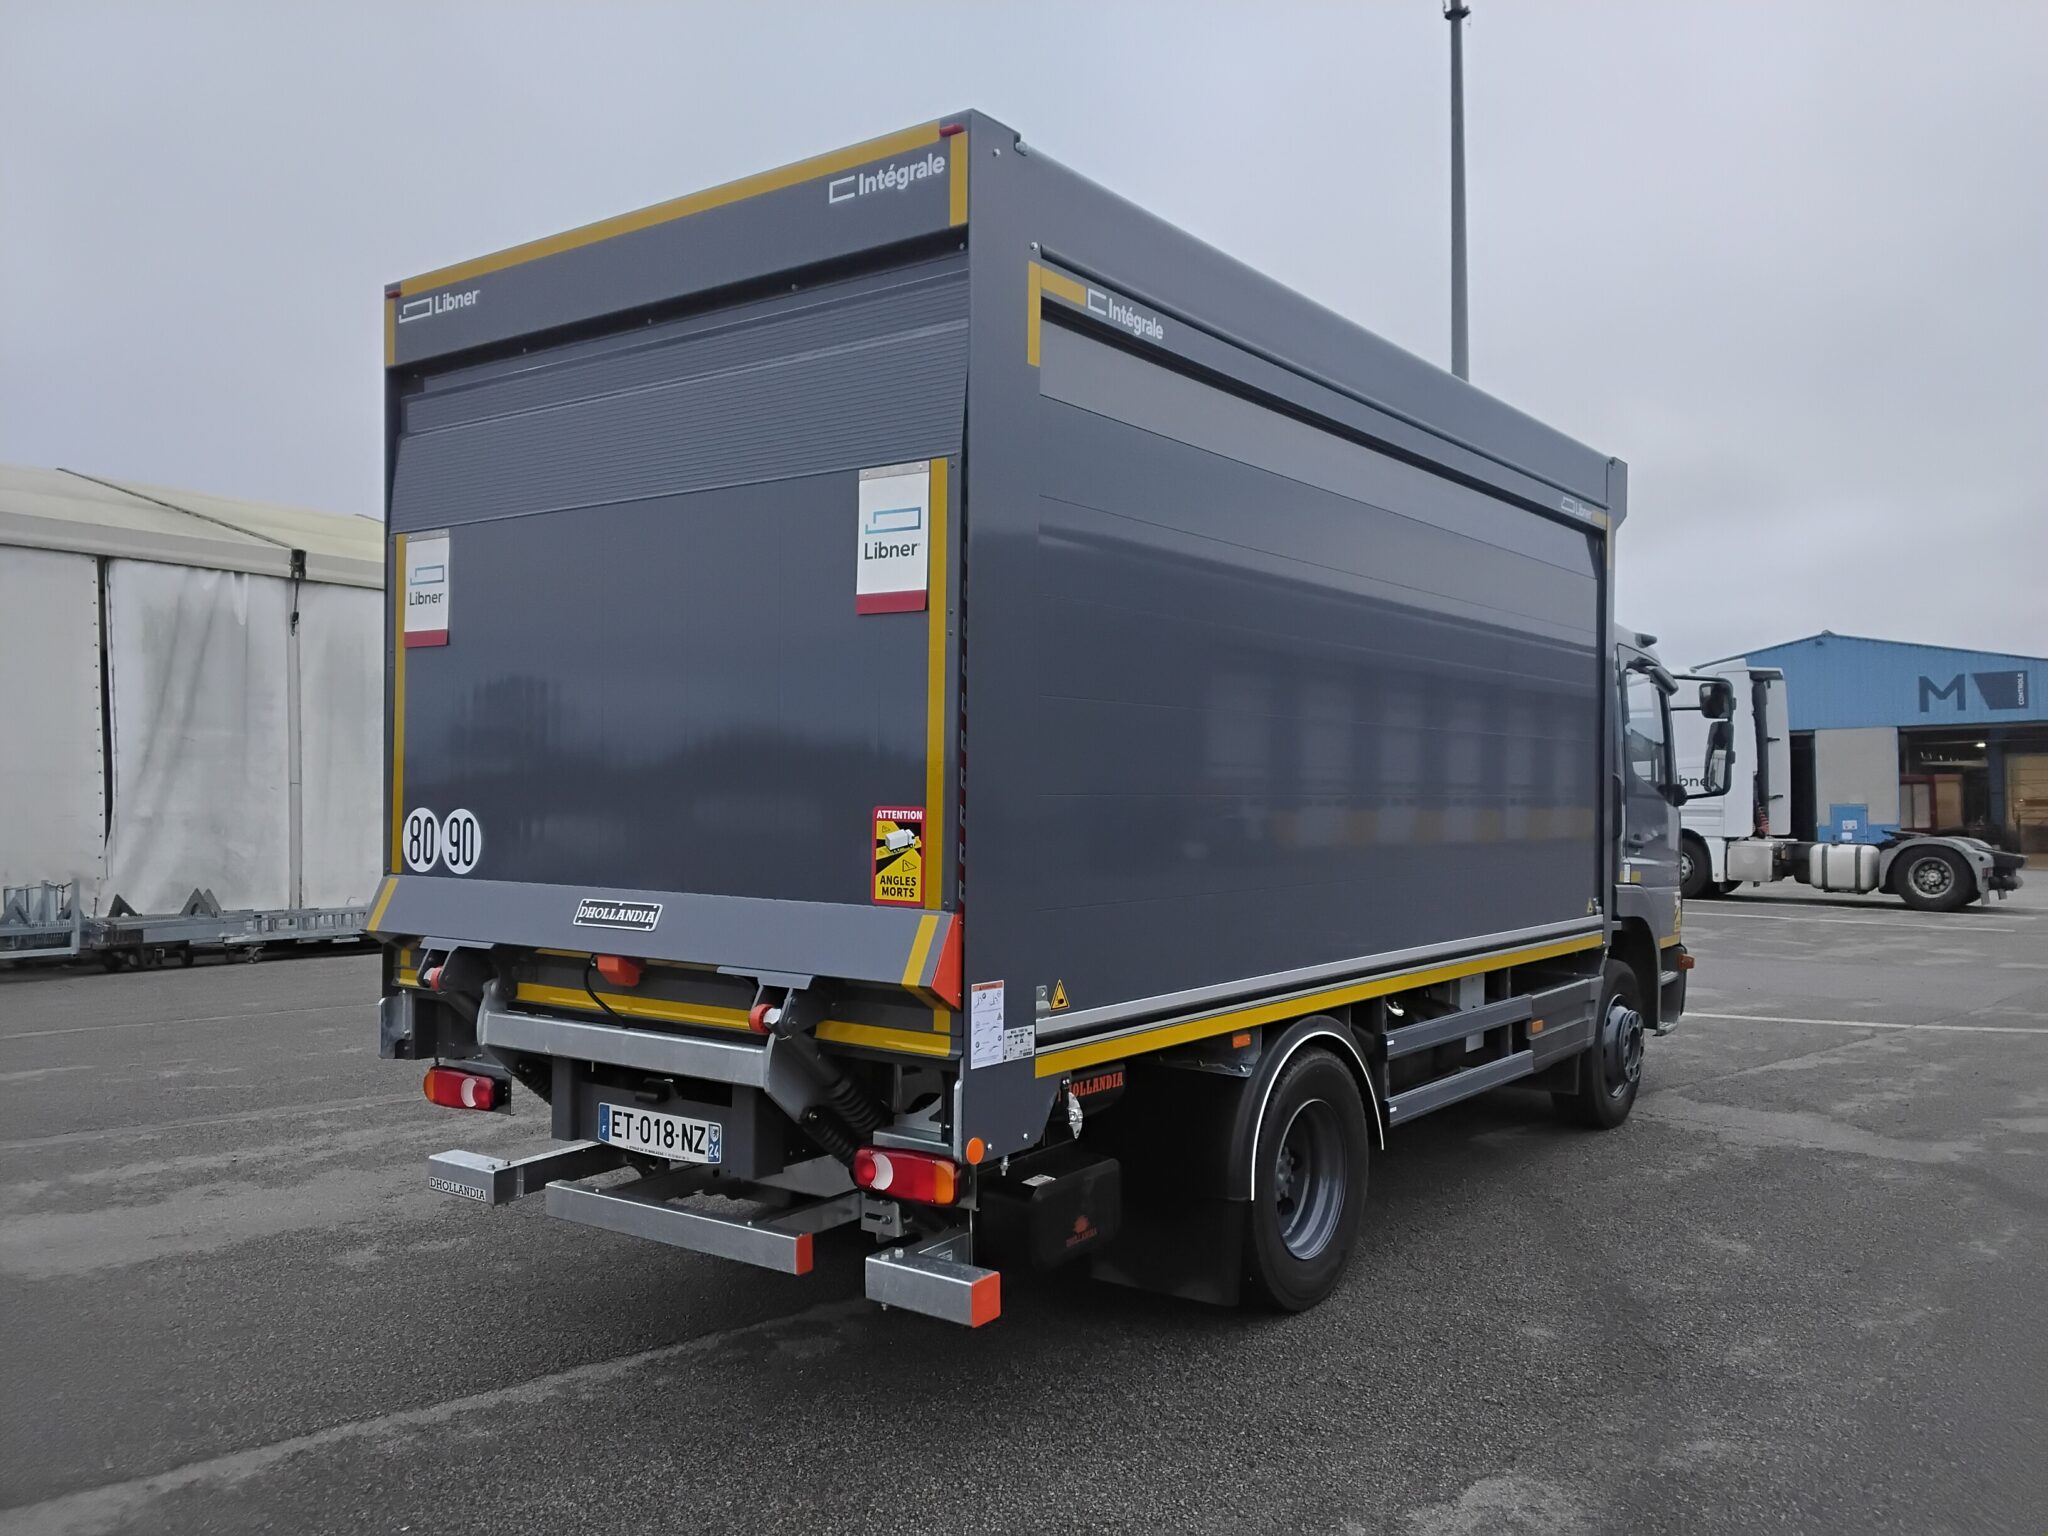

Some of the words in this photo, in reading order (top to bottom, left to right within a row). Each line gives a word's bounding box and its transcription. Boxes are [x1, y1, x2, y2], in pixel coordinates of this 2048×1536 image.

[858, 153, 946, 197] Intégrale
[434, 289, 480, 314] Libner
[1108, 302, 1164, 340] Intégrale
[864, 541, 919, 560] Libner
[409, 591, 444, 606] Libner
[876, 809, 923, 820] ATTENTION
[409, 815, 435, 865] 80
[448, 817, 475, 867] 90
[879, 875, 917, 887] ANGLES
[881, 886, 915, 898] MORTS
[578, 905, 655, 924] DHOLLANDIA
[602, 1125, 607, 1134] F
[708, 1143, 720, 1159] 24
[430, 1177, 486, 1201] DHOLLANDIA
